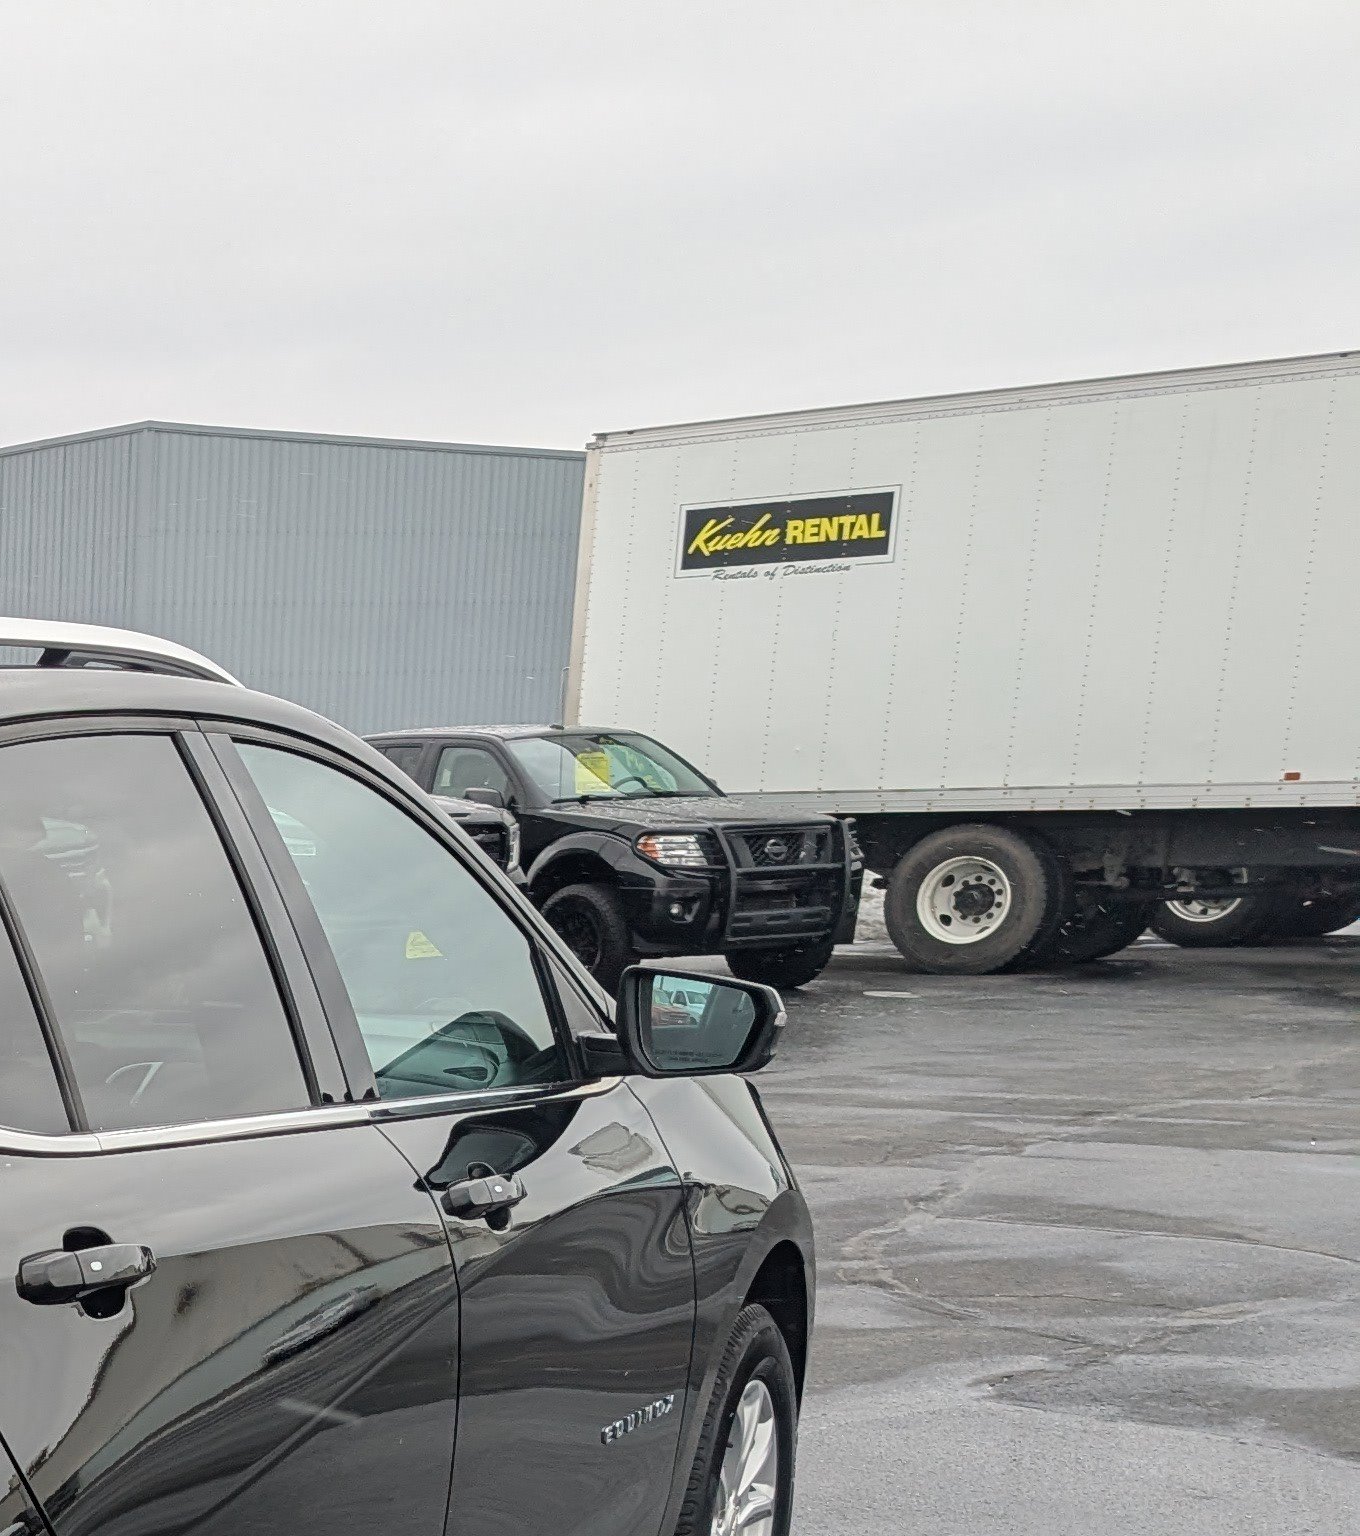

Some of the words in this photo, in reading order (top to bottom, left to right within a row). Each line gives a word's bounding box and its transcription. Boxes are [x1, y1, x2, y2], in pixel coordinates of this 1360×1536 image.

[687, 512, 780, 557] Kuehn
[784, 512, 887, 545] RENTAL
[710, 568, 759, 581] Rentals
[763, 566, 779, 580] of
[782, 563, 853, 577] Distinction
